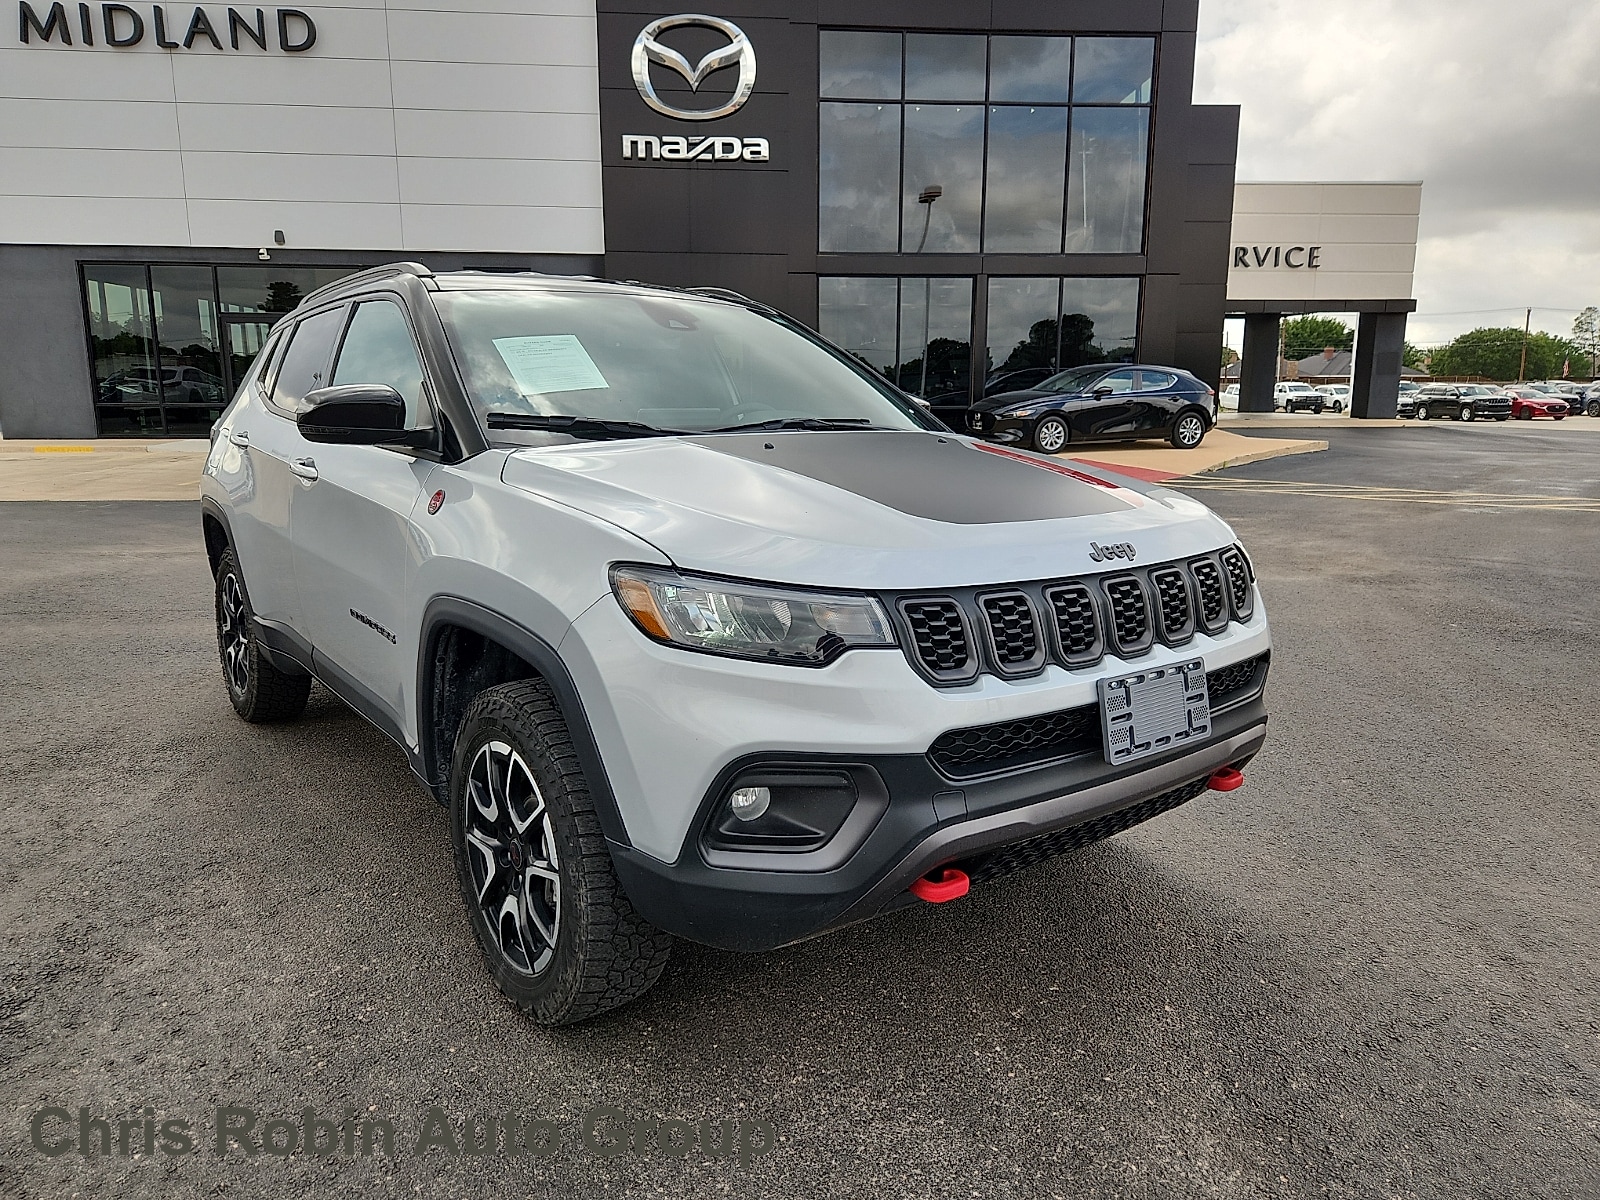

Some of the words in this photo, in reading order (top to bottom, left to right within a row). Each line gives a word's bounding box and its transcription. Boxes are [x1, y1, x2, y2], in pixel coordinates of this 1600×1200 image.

[19, 1, 317, 52] MIDLAND
[1233, 246, 1322, 268] RVICE
[1089, 541, 1137, 562] Jeep
